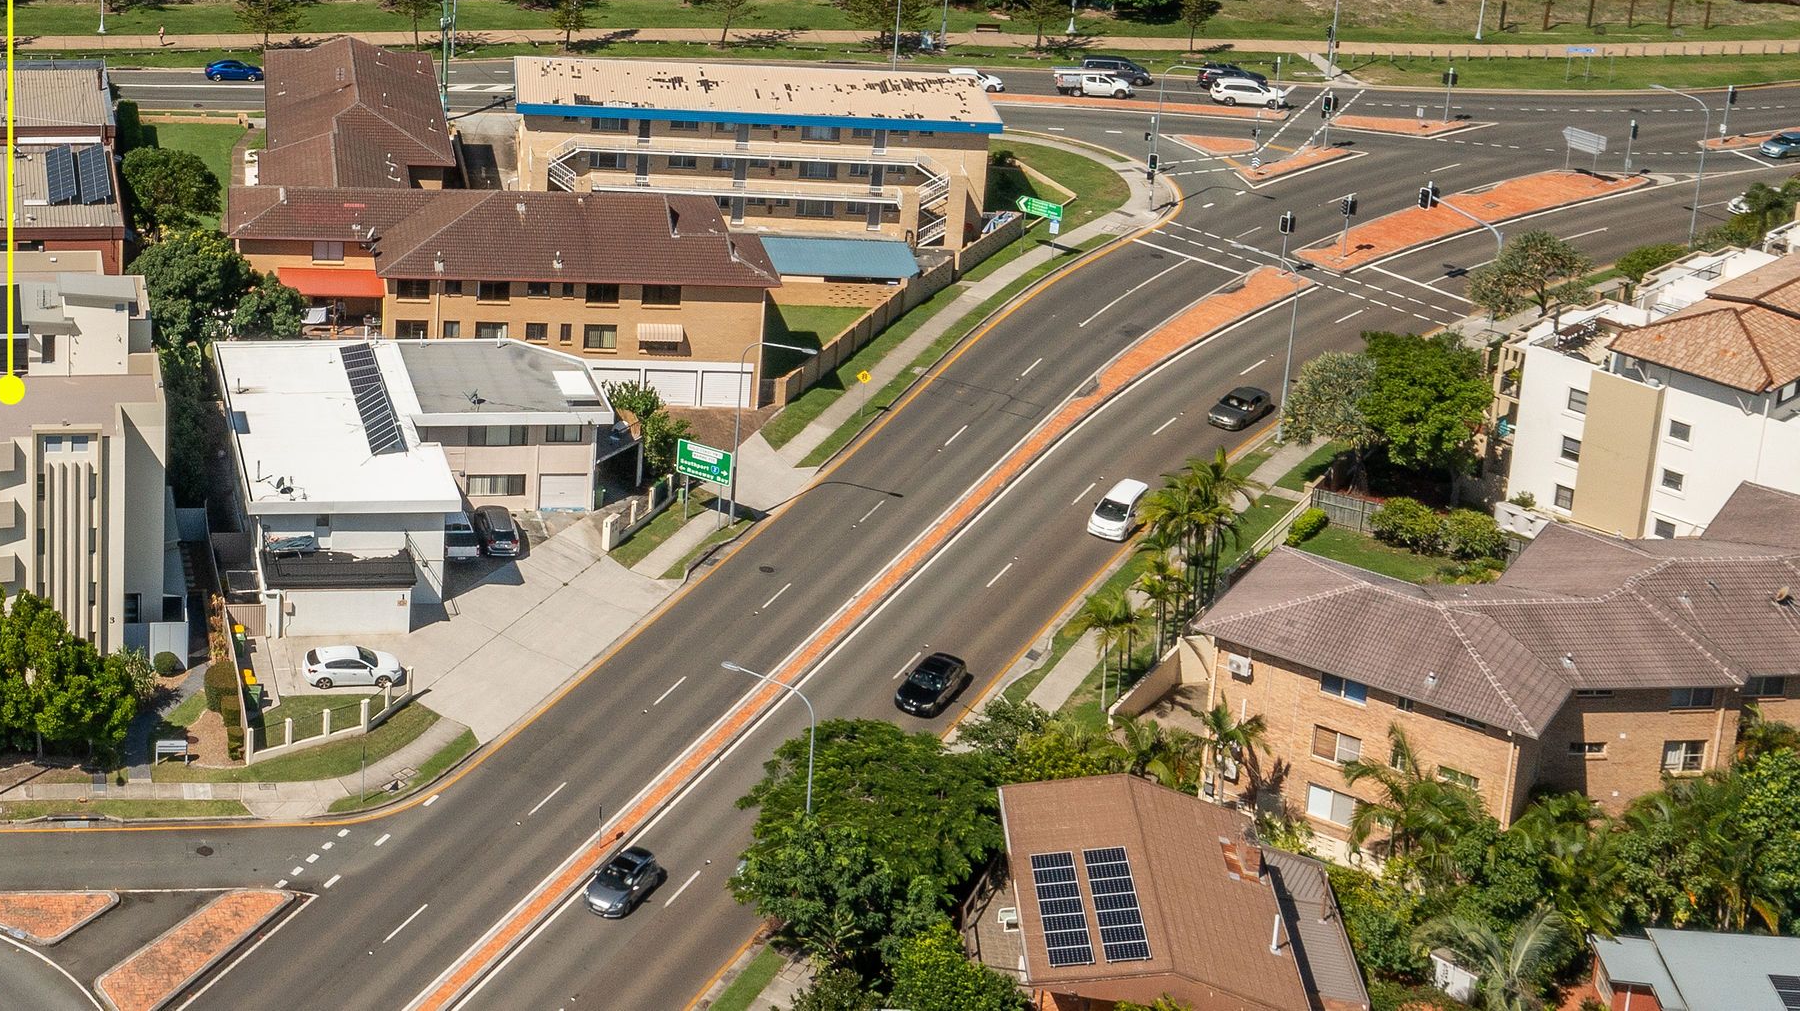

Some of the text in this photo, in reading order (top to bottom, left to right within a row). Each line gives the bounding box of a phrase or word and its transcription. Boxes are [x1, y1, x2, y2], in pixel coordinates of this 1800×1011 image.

[680, 458, 709, 471] Southport
[686, 467, 729, 484] Runaway Bay
[109, 616, 116, 624] 3
